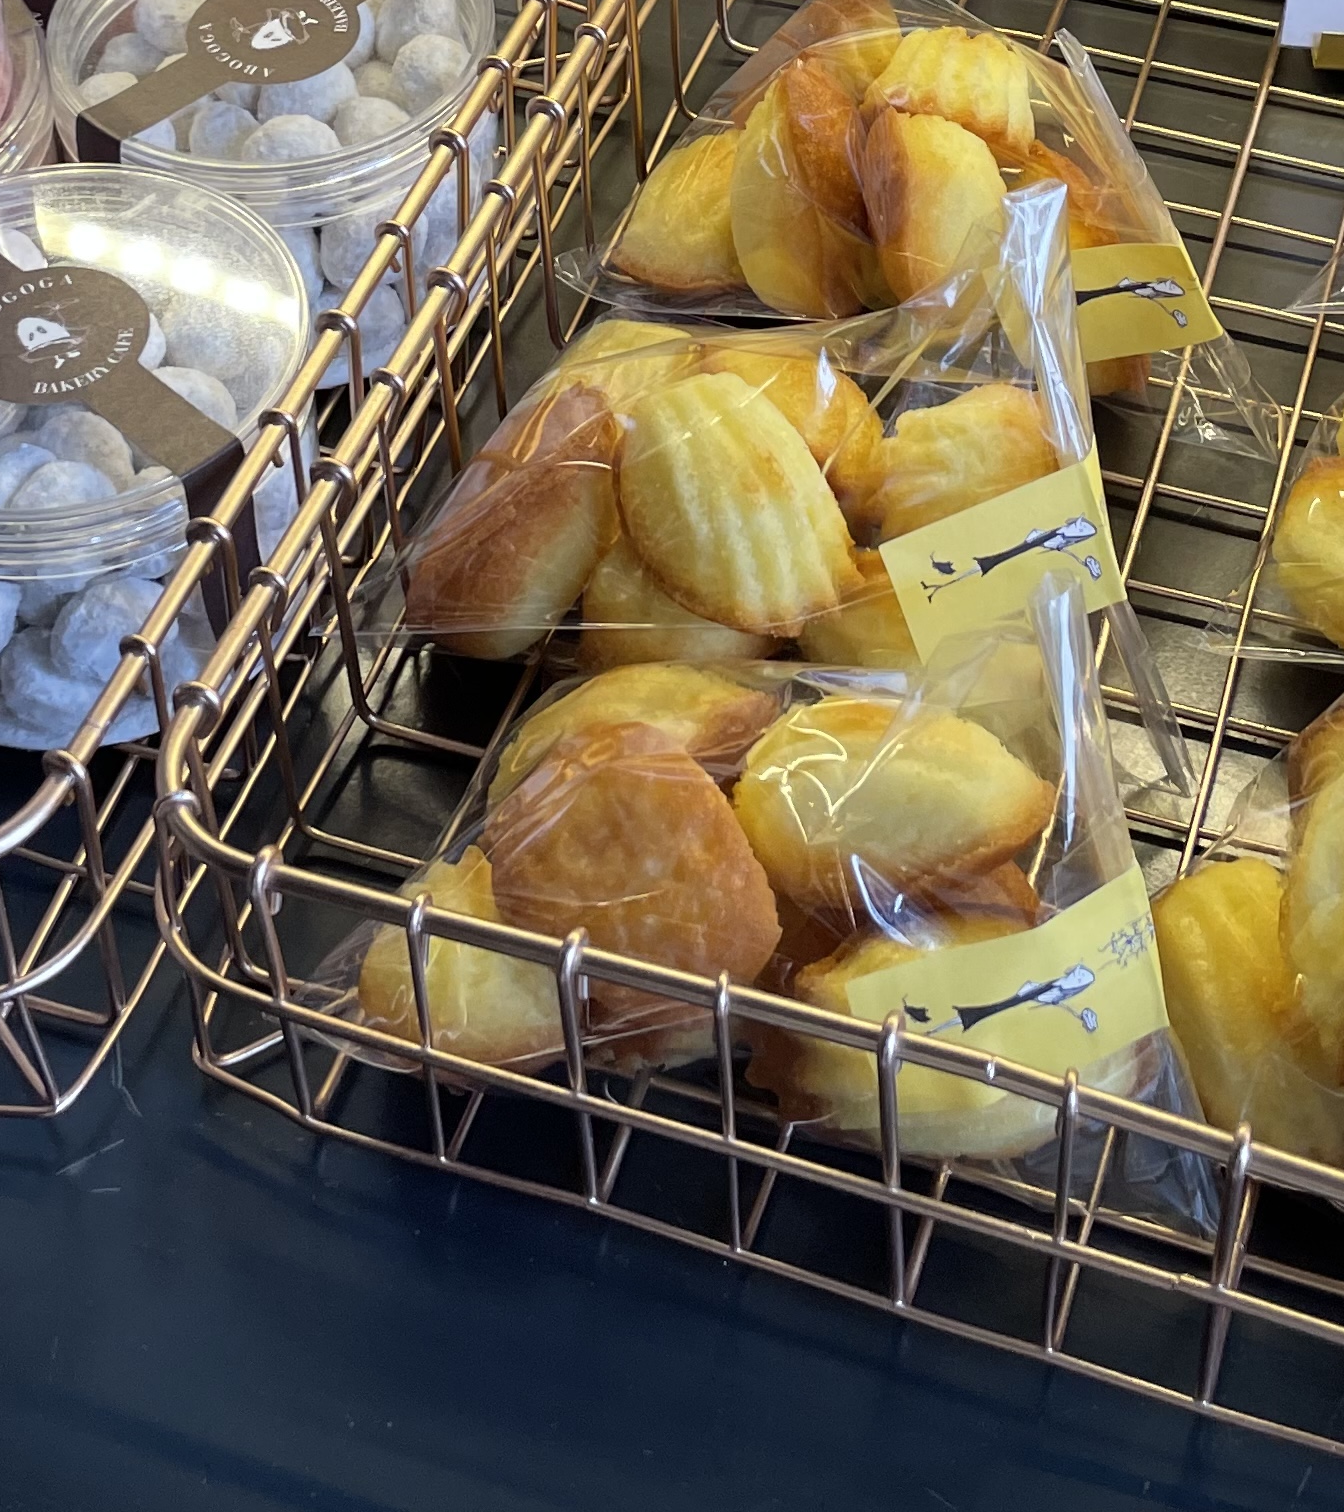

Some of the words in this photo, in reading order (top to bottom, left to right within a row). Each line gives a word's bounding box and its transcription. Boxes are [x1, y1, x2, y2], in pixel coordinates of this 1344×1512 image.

[198, 22, 276, 78] ABOGOGA
[33, 365, 110, 395] BAKERY
[107, 327, 134, 364] CAFE
